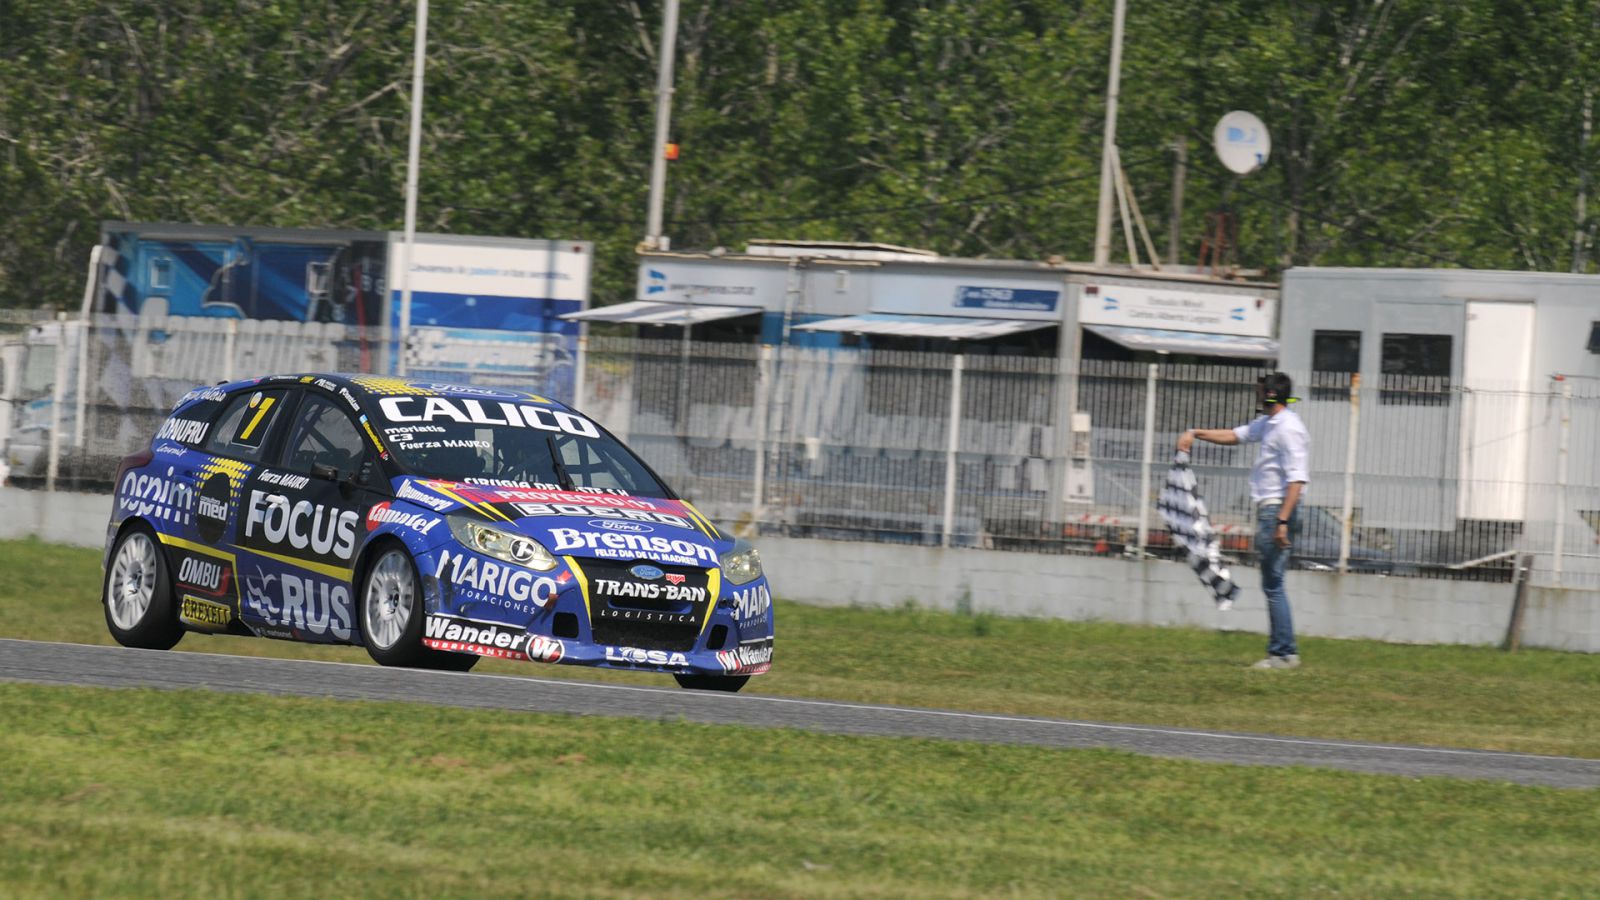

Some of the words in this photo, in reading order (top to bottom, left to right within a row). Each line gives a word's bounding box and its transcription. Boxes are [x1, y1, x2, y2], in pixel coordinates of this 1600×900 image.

[240, 397, 276, 440] 1
[379, 397, 600, 439] CALICO
[388, 433, 414, 443] C3
[399, 440, 442, 451] Fuerza
[443, 439, 491, 449] MAURO
[258, 469, 282, 484] Fuerza
[278, 473, 310, 490] MAURO
[198, 500, 229, 521] med
[495, 489, 626, 509] PROYECTO
[245, 489, 360, 560] FOCUS
[517, 502, 690, 528] BOERO
[601, 520, 642, 533] Ford
[548, 527, 721, 567] Brenson
[595, 549, 618, 558] FELIZ
[620, 550, 635, 560] DIA
[636, 551, 649, 560] DE
[649, 551, 661, 560] LA
[178, 556, 221, 590] OMBU
[435, 550, 558, 608] MARIGO
[595, 578, 706, 602] TRANS-BAN
[281, 573, 351, 640] RUS
[425, 616, 528, 650] Wander
[423, 638, 522, 659] LUBRICANTES
